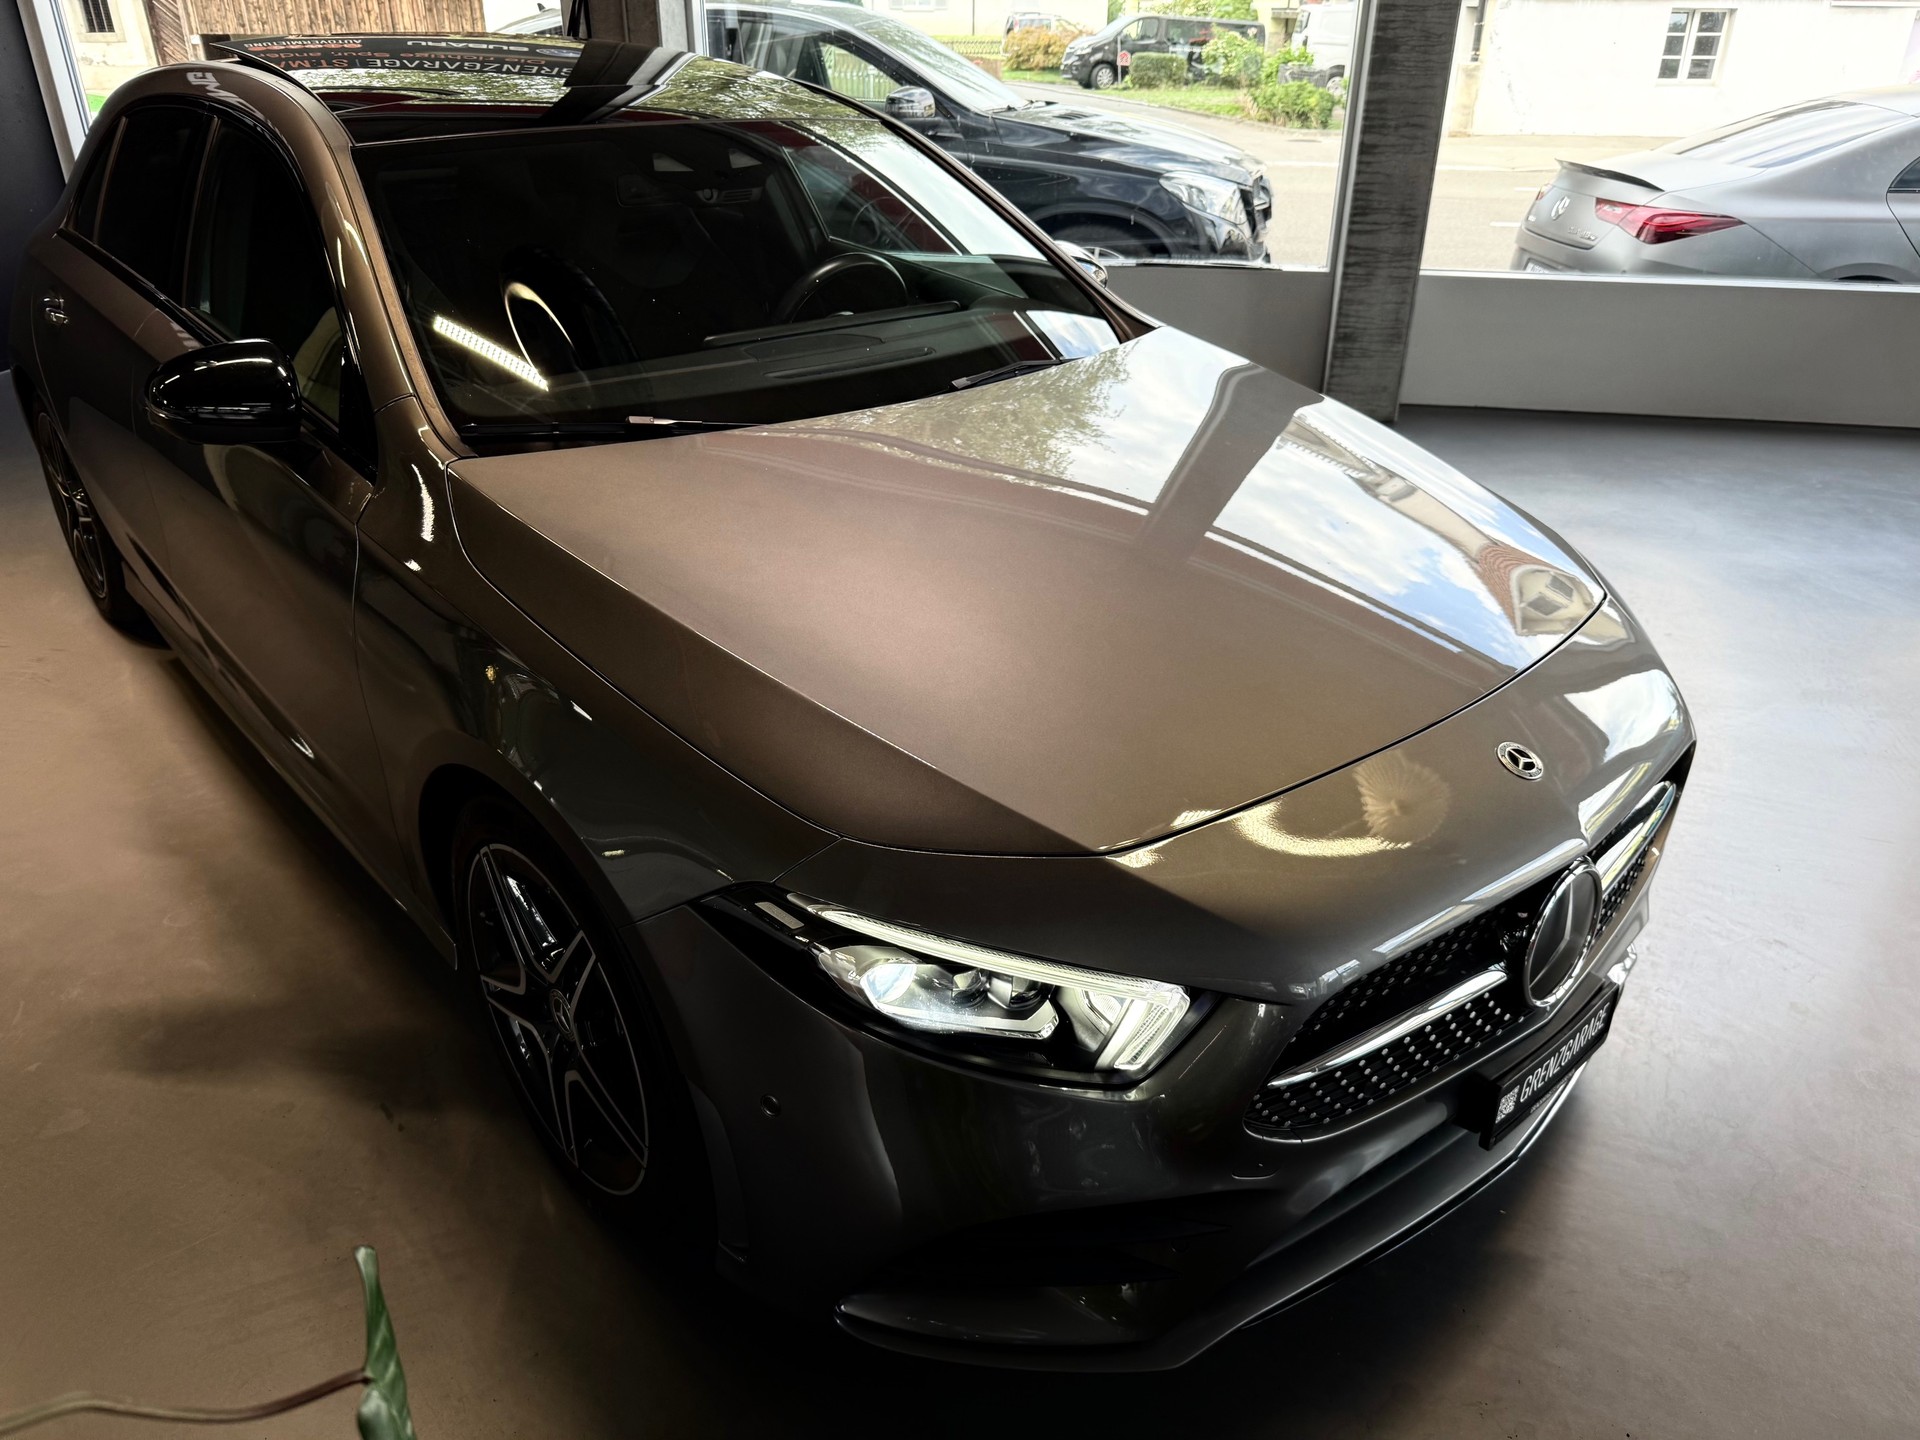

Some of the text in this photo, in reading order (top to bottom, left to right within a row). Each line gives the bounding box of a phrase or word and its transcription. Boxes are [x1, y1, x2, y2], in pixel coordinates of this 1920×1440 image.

[407, 40, 530, 51] SUBARU
[400, 52, 495, 61] richtige
[505, 57, 546, 65] Die
[368, 59, 573, 77] GRENZGARAGE
[1519, 1002, 1611, 1103] GRENZGARAGE
